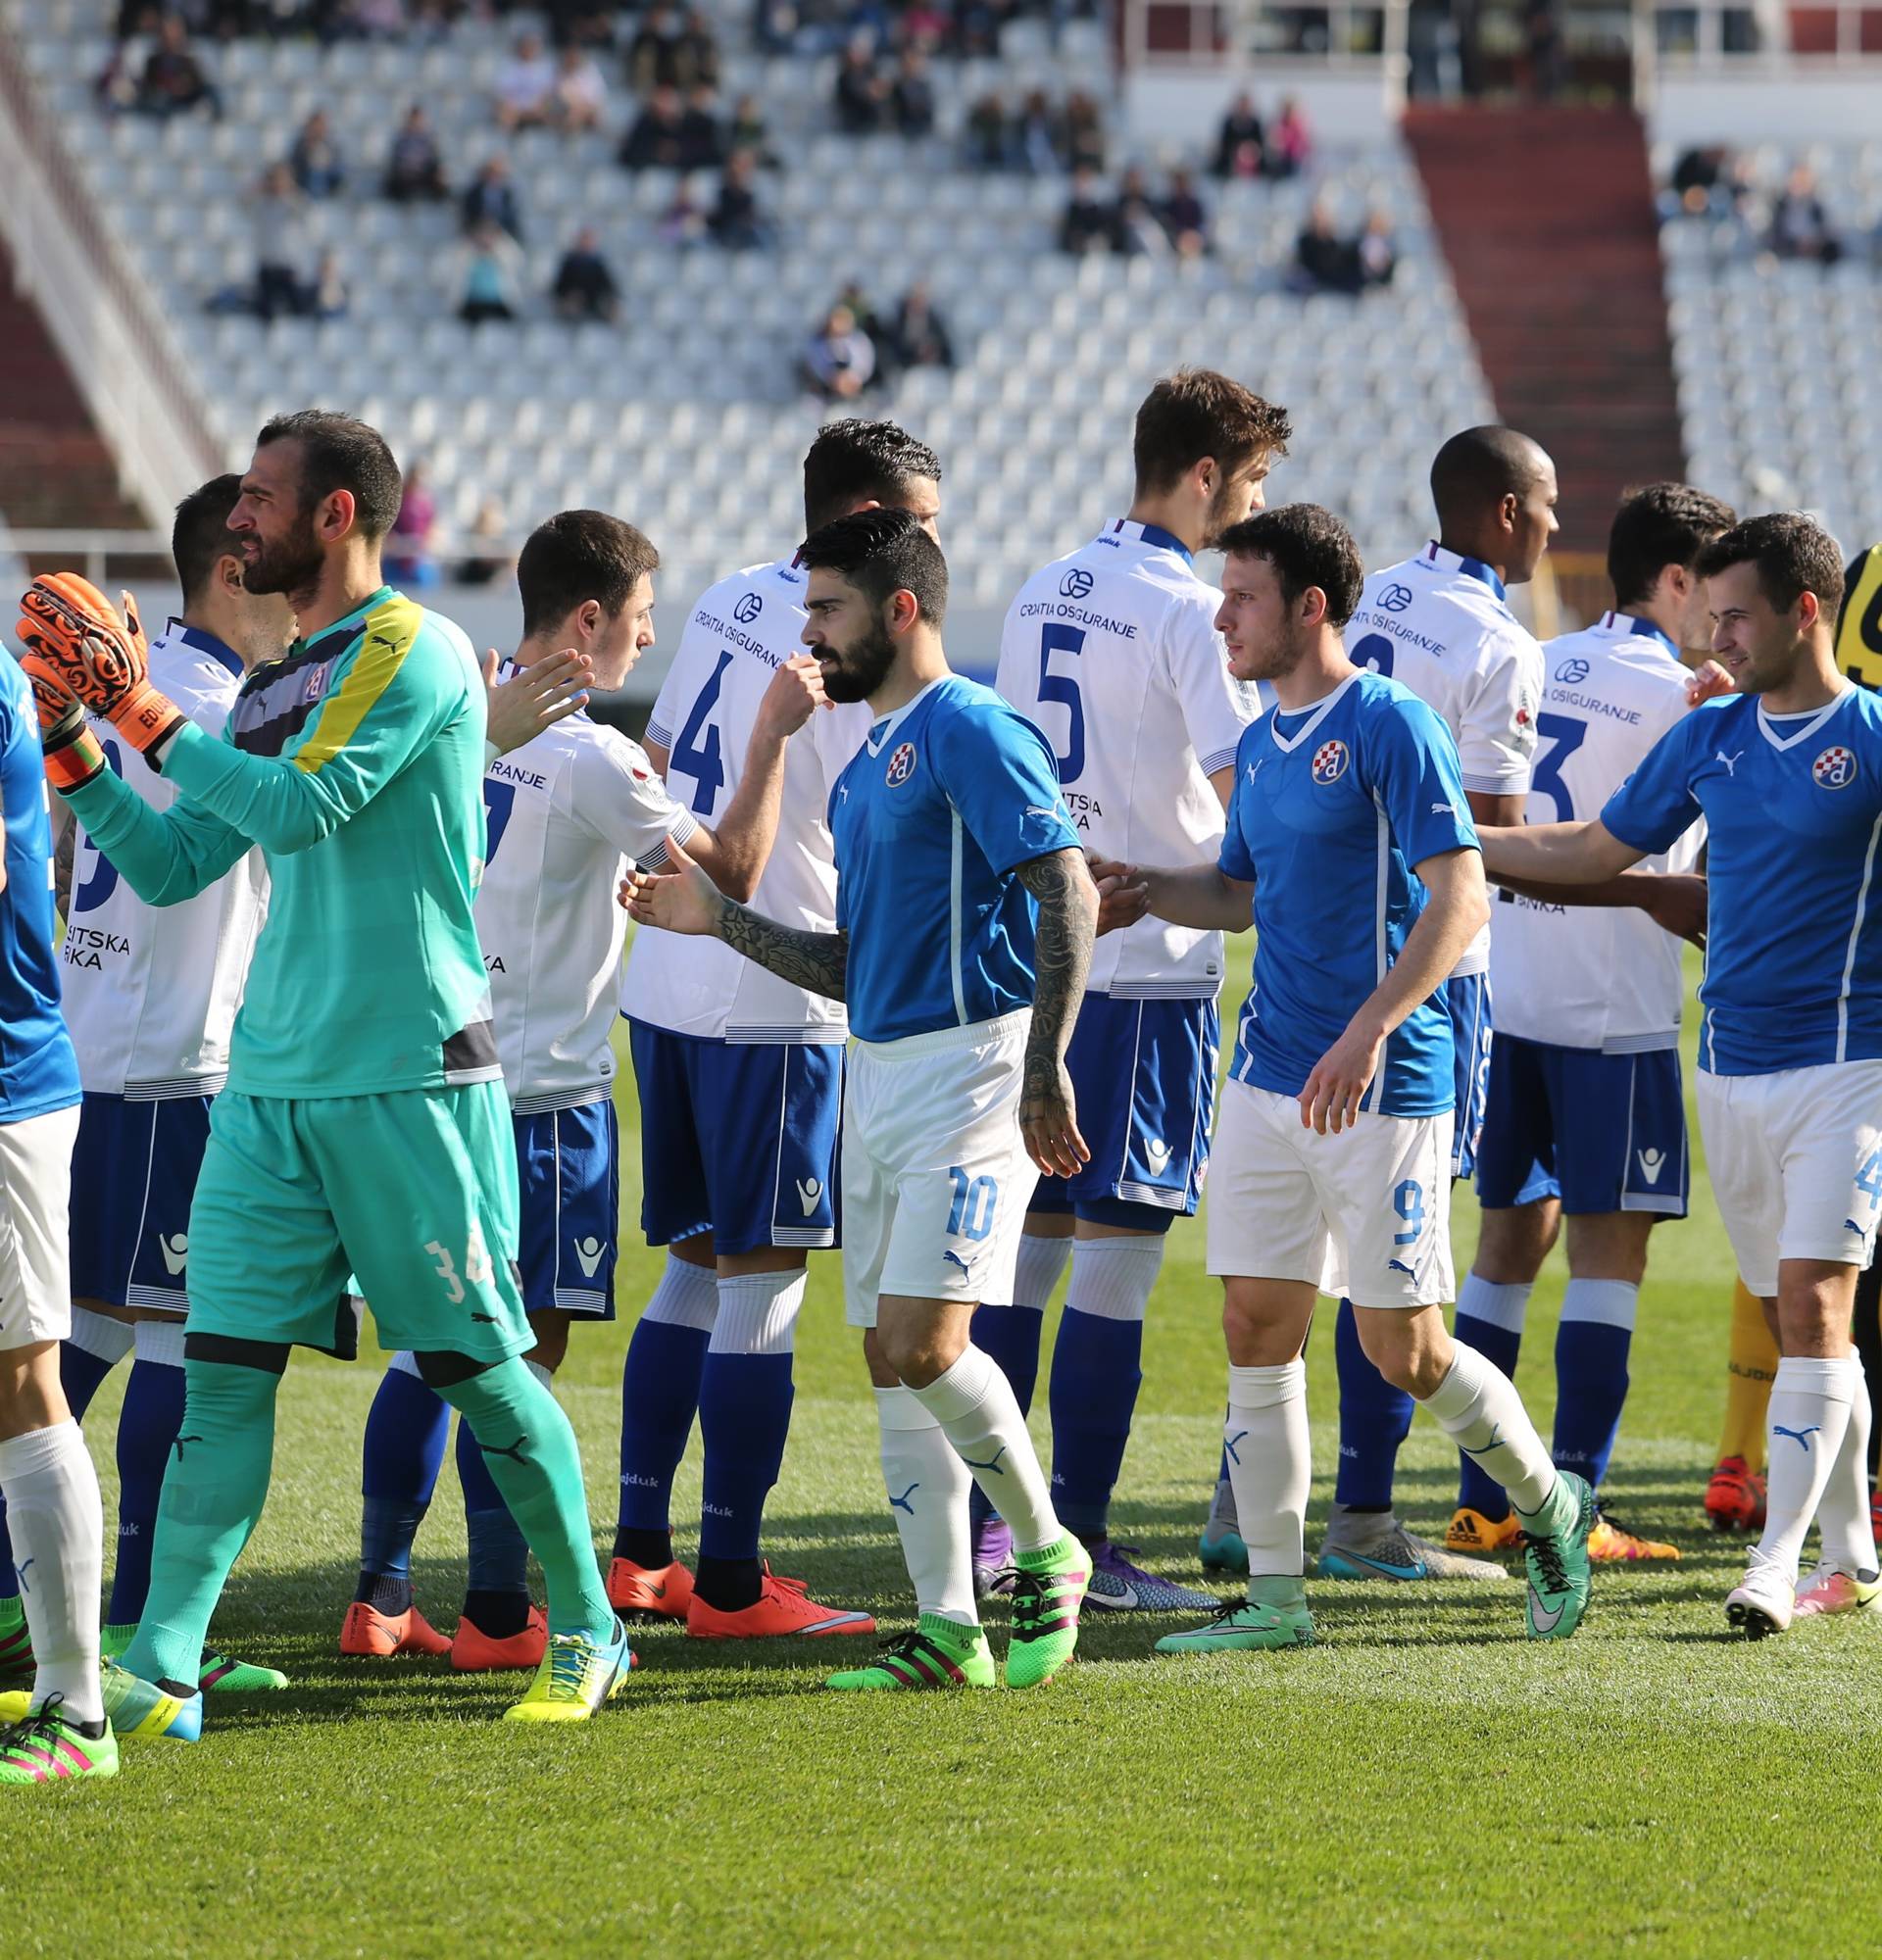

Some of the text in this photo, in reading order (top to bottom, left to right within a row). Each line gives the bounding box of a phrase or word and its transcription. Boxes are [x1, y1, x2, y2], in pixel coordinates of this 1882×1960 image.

[724, 626, 783, 669] OSIGURAN
[1372, 612, 1447, 658] OSIGURANJE
[669, 650, 734, 816] 4
[1037, 622, 1086, 784] 5
[1551, 688, 1642, 725] OSIGURANJE
[490, 760, 547, 790] RANJE
[1523, 711, 1588, 824] 3
[946, 1165, 999, 1243] 10
[1393, 1179, 1426, 1246] 9
[1854, 1150, 1882, 1211] 4
[423, 1219, 496, 1304] 34
